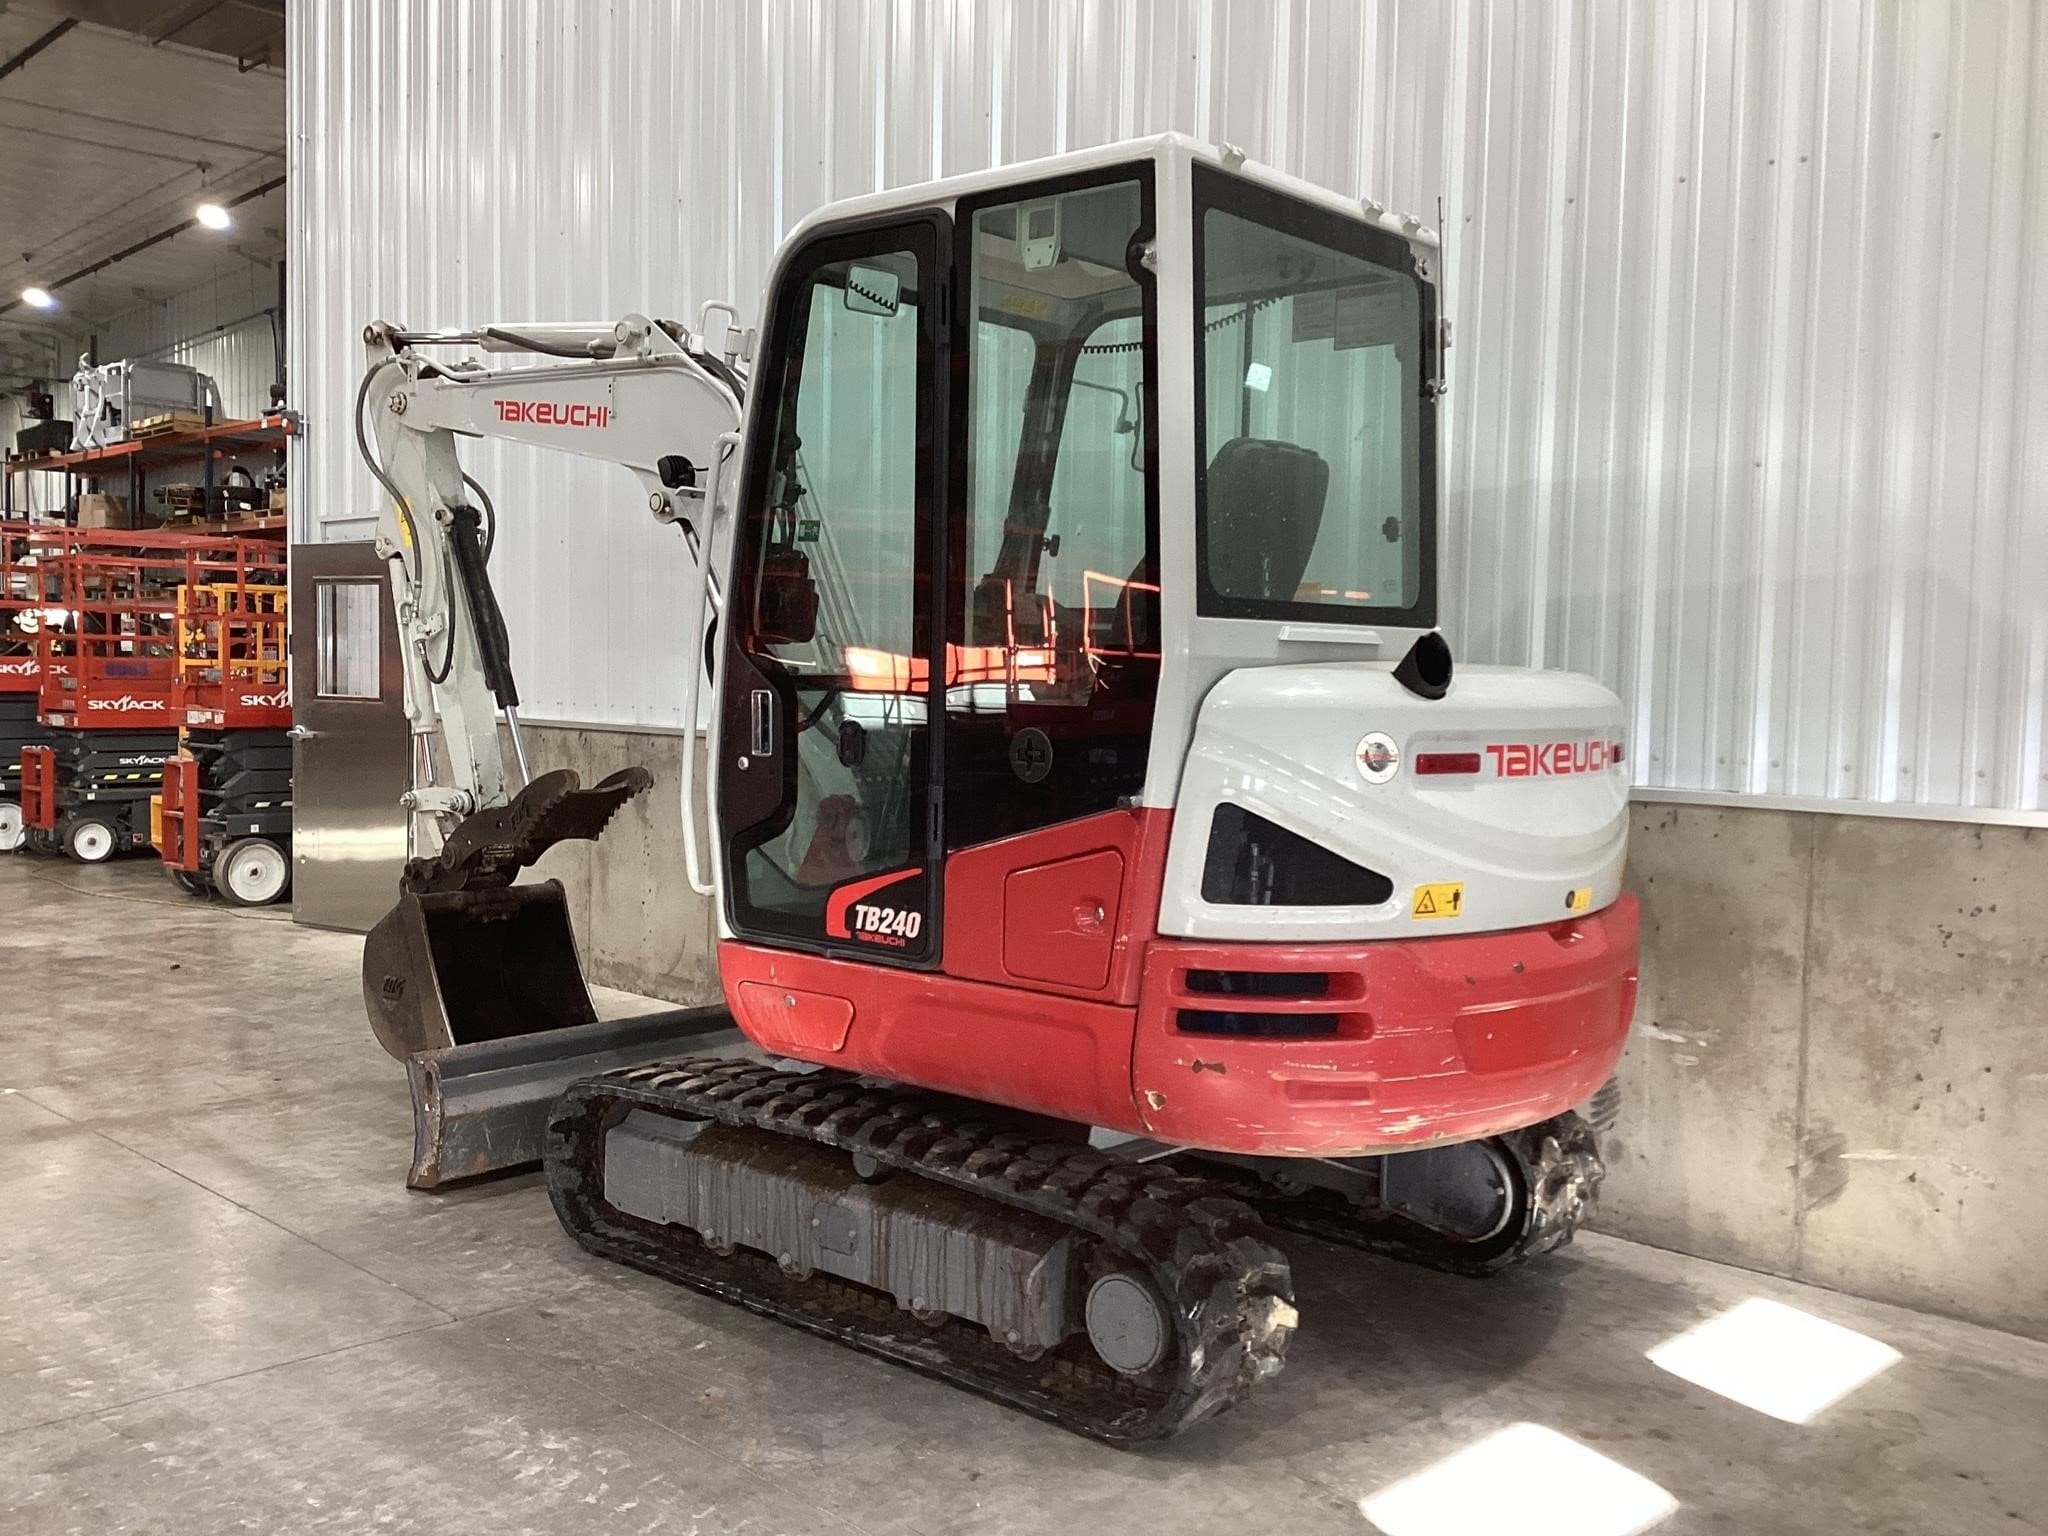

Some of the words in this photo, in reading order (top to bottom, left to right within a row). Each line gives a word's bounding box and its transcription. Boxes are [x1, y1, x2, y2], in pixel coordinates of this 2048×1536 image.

[494, 400, 608, 428] TAKEUCHI
[88, 695, 165, 711] SKYJACK
[855, 904, 921, 938] TB240
